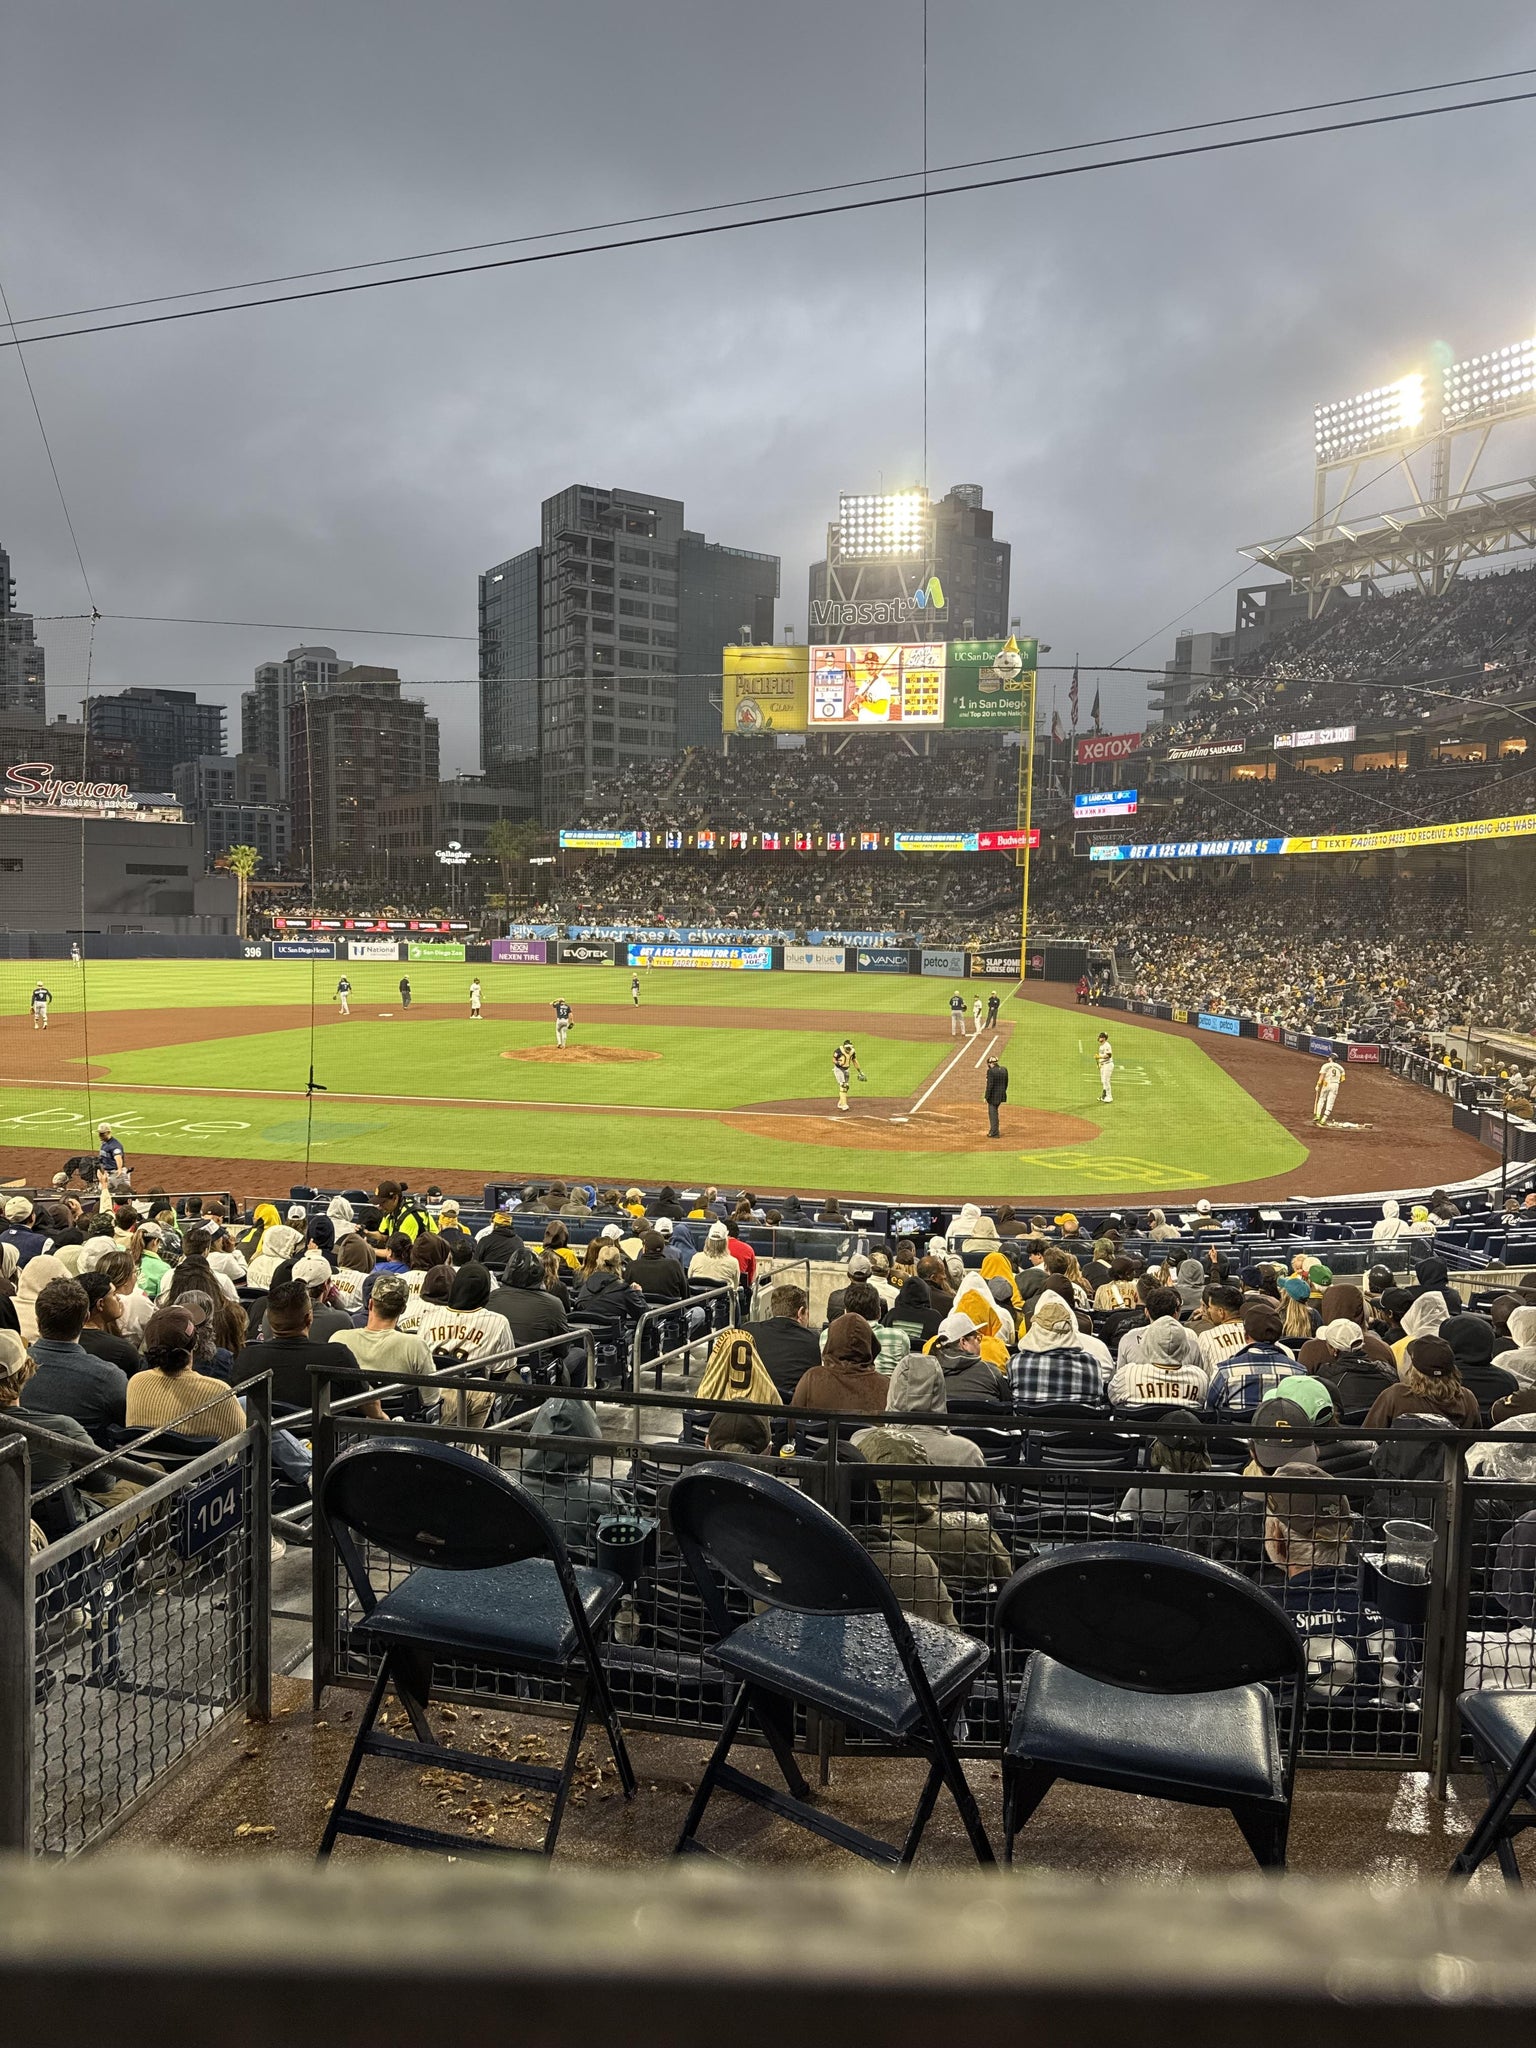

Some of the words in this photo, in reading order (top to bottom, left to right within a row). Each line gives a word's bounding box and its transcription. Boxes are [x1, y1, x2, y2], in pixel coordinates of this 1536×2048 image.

[813, 597, 905, 625] Viasat
[954, 652, 967, 661] UC
[968, 652, 982, 661] San
[969, 699, 977, 709] in
[979, 699, 997, 709] San
[999, 699, 1027, 710] Diego
[1083, 738, 1133, 760] xerox
[1168, 746, 1208, 760] Tarantino
[1209, 744, 1243, 754] SAUSAGES
[4, 762, 133, 805] Sycuan
[1325, 839, 1346, 848] TEXT
[1408, 832, 1417, 842] TO
[435, 850, 472, 859] Gallagher
[1149, 844, 1156, 857] A
[1178, 843, 1197, 856] CAR
[1201, 841, 1228, 855] WASH
[1232, 840, 1251, 854] FOR
[440, 857, 466, 865] Square
[244, 947, 262, 957] 396
[676, 948, 690, 957] CAR
[714, 948, 729, 958] FOR
[786, 952, 804, 961] blue
[816, 953, 834, 962] blue
[924, 957, 949, 968] petco
[986, 958, 1003, 966] SLAP
[1331, 1068, 1337, 1077] 9
[430, 1325, 466, 1342] TATIS
[1213, 1331, 1245, 1348] TATI
[730, 1340, 753, 1389] 9
[1136, 1383, 1179, 1399] TATIS
[1185, 1384, 1200, 1401] JR.
[625, 1447, 639, 1458] 13
[198, 1487, 236, 1534] 104
